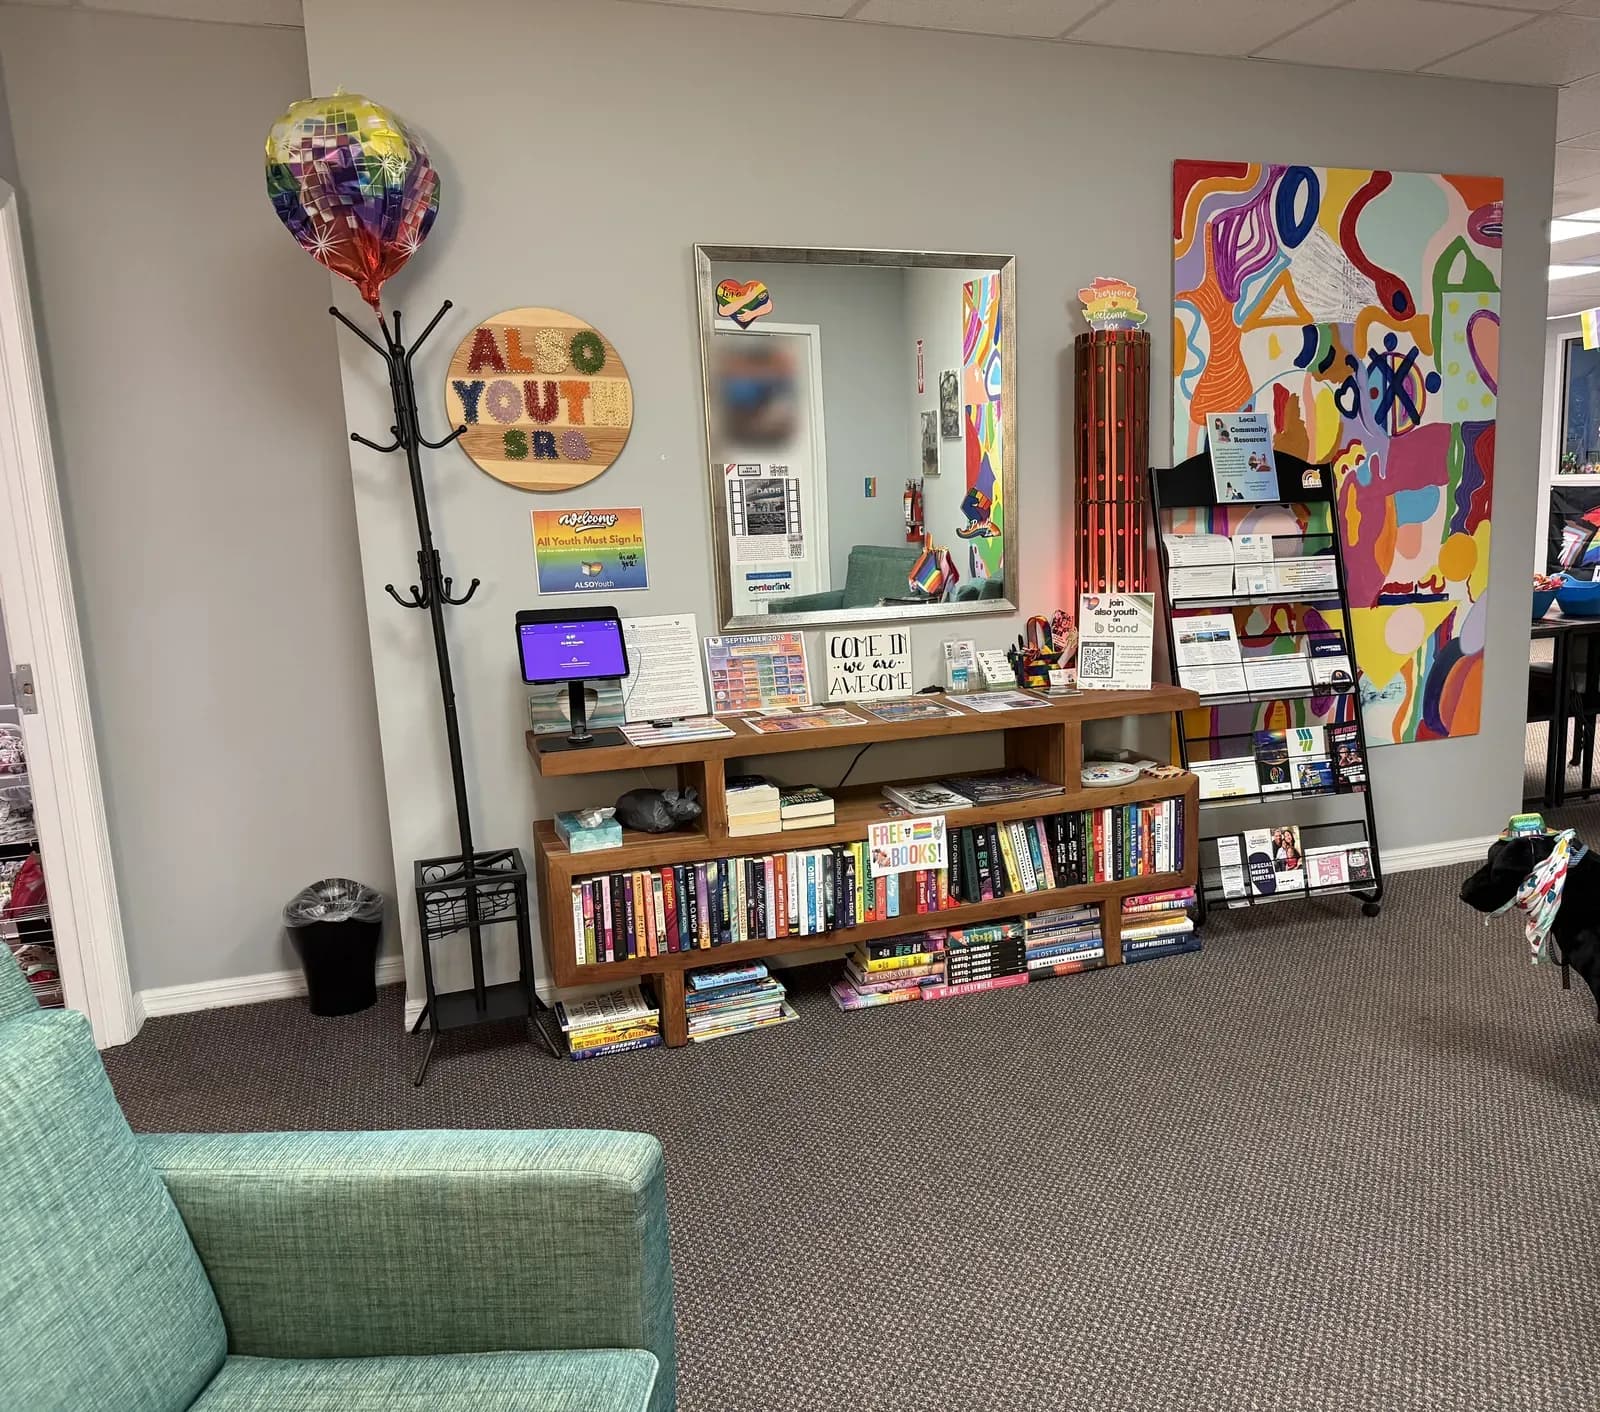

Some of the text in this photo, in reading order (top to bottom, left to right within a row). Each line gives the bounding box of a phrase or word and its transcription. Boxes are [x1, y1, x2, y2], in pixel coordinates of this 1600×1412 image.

[467, 327, 606, 375] ALSO
[451, 380, 630, 426] YOUTH
[1230, 426, 1267, 434] Community
[502, 428, 593, 461] SRQ
[1233, 436, 1267, 444] Resources
[537, 534, 643, 547] All Youth Must Sign In
[748, 582, 791, 592] centerlink
[1109, 598, 1124, 608] join
[1094, 608, 1138, 617] also youth
[1107, 623, 1139, 633] band
[725, 636, 768, 644] SEPTEMBER
[830, 633, 908, 658] COME IN
[843, 659, 897, 673] we are
[830, 671, 912, 695] AWESOME
[872, 823, 904, 846] FREE
[891, 842, 942, 867] BOOKS!
[1170, 900, 1185, 908] LOVE
[1131, 941, 1148, 949] CAMP
[1037, 950, 1052, 958] LOST
[1054, 947, 1074, 955] STORY
